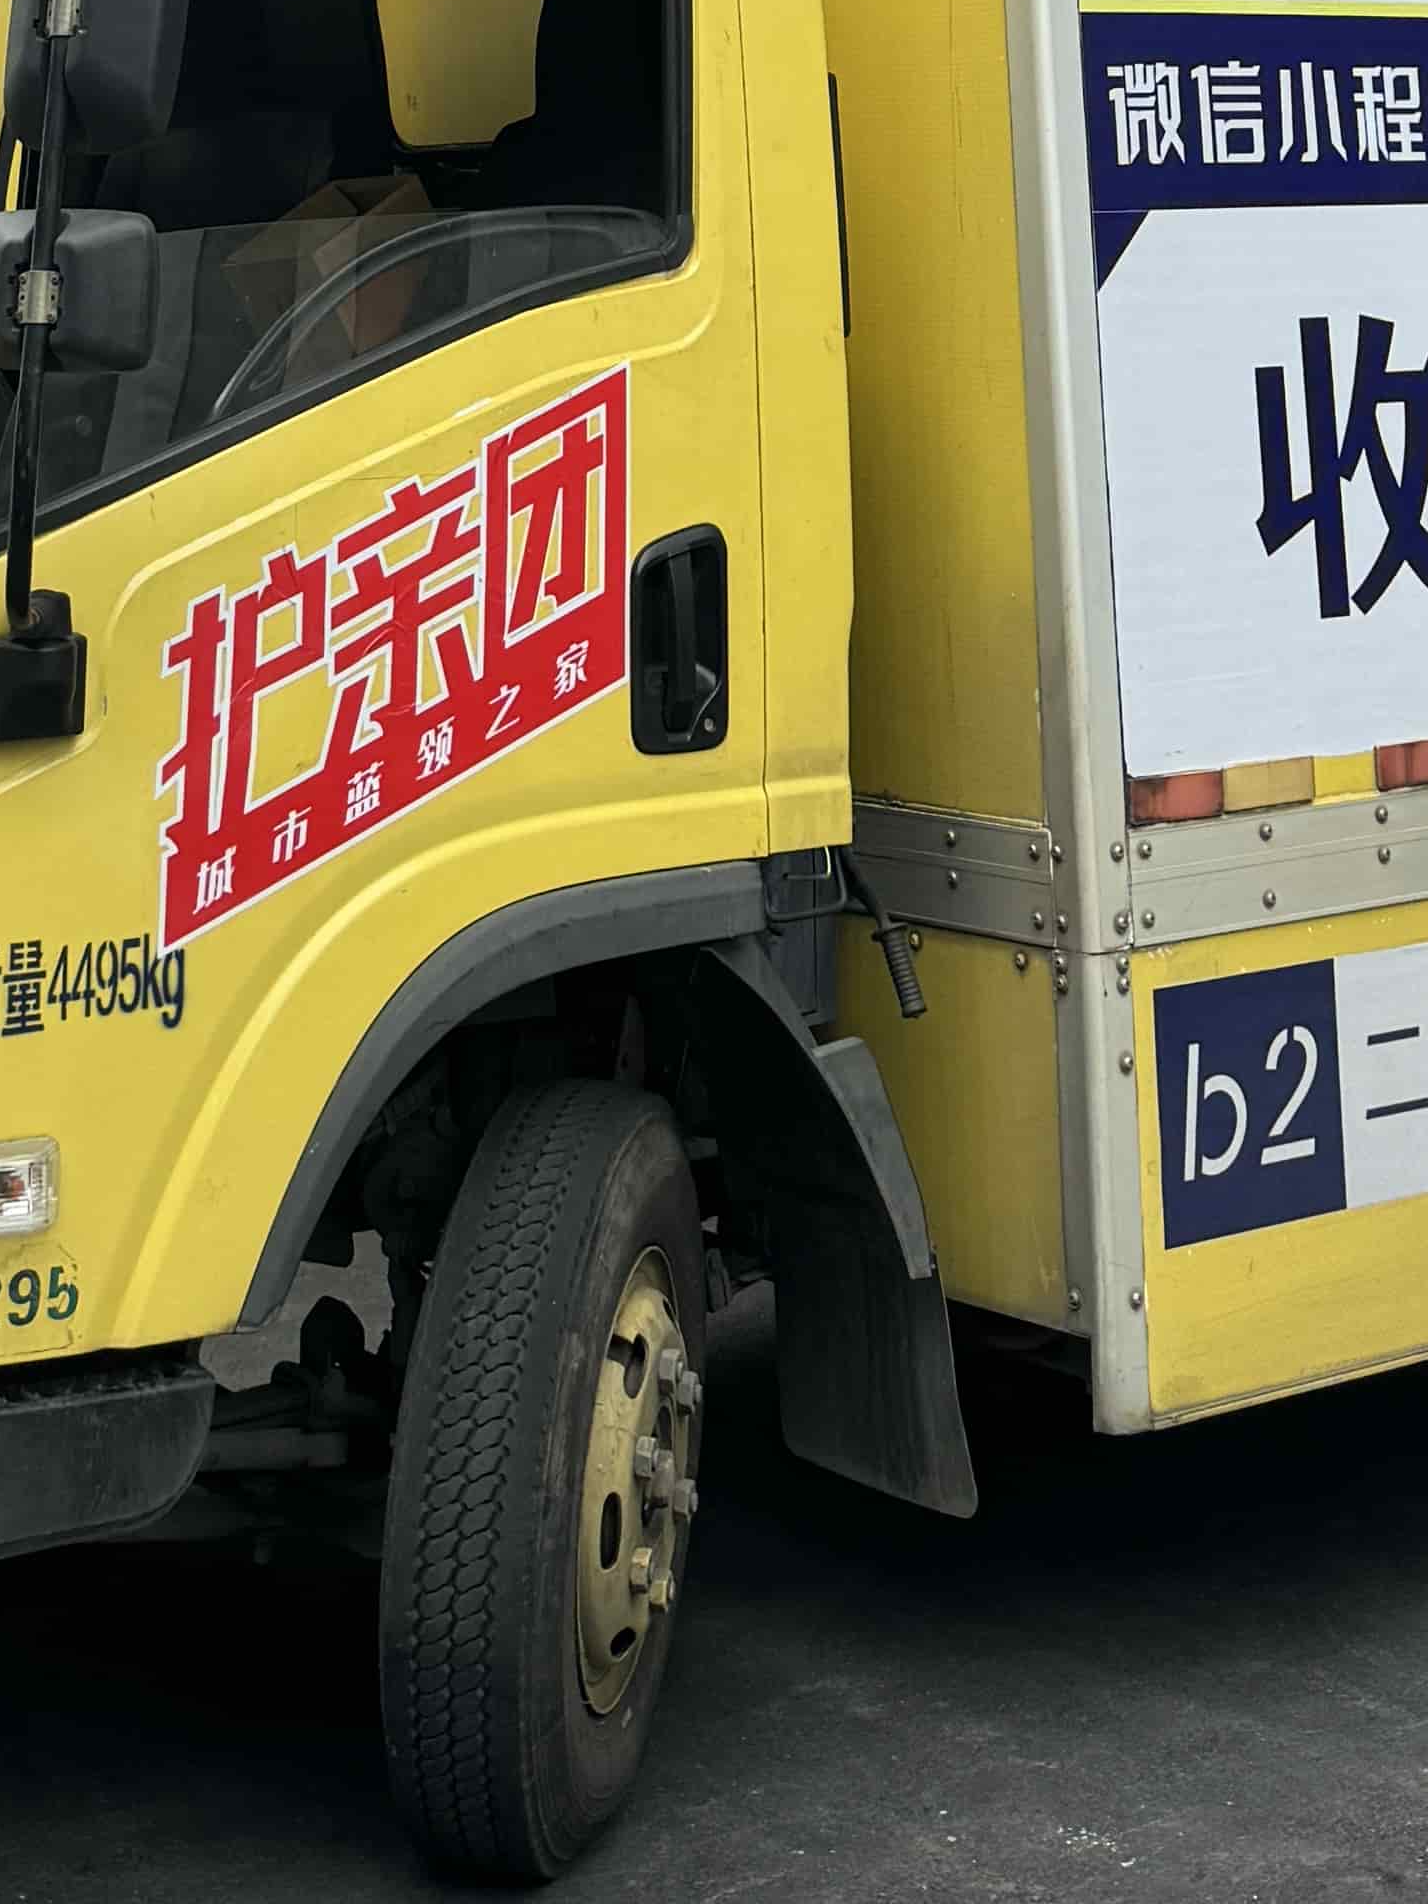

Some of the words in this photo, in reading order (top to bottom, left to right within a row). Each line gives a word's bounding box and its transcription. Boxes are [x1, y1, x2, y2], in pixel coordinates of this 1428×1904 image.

[162, 369, 625, 840] 护亲团
[1181, 1024, 1320, 1183] b2
